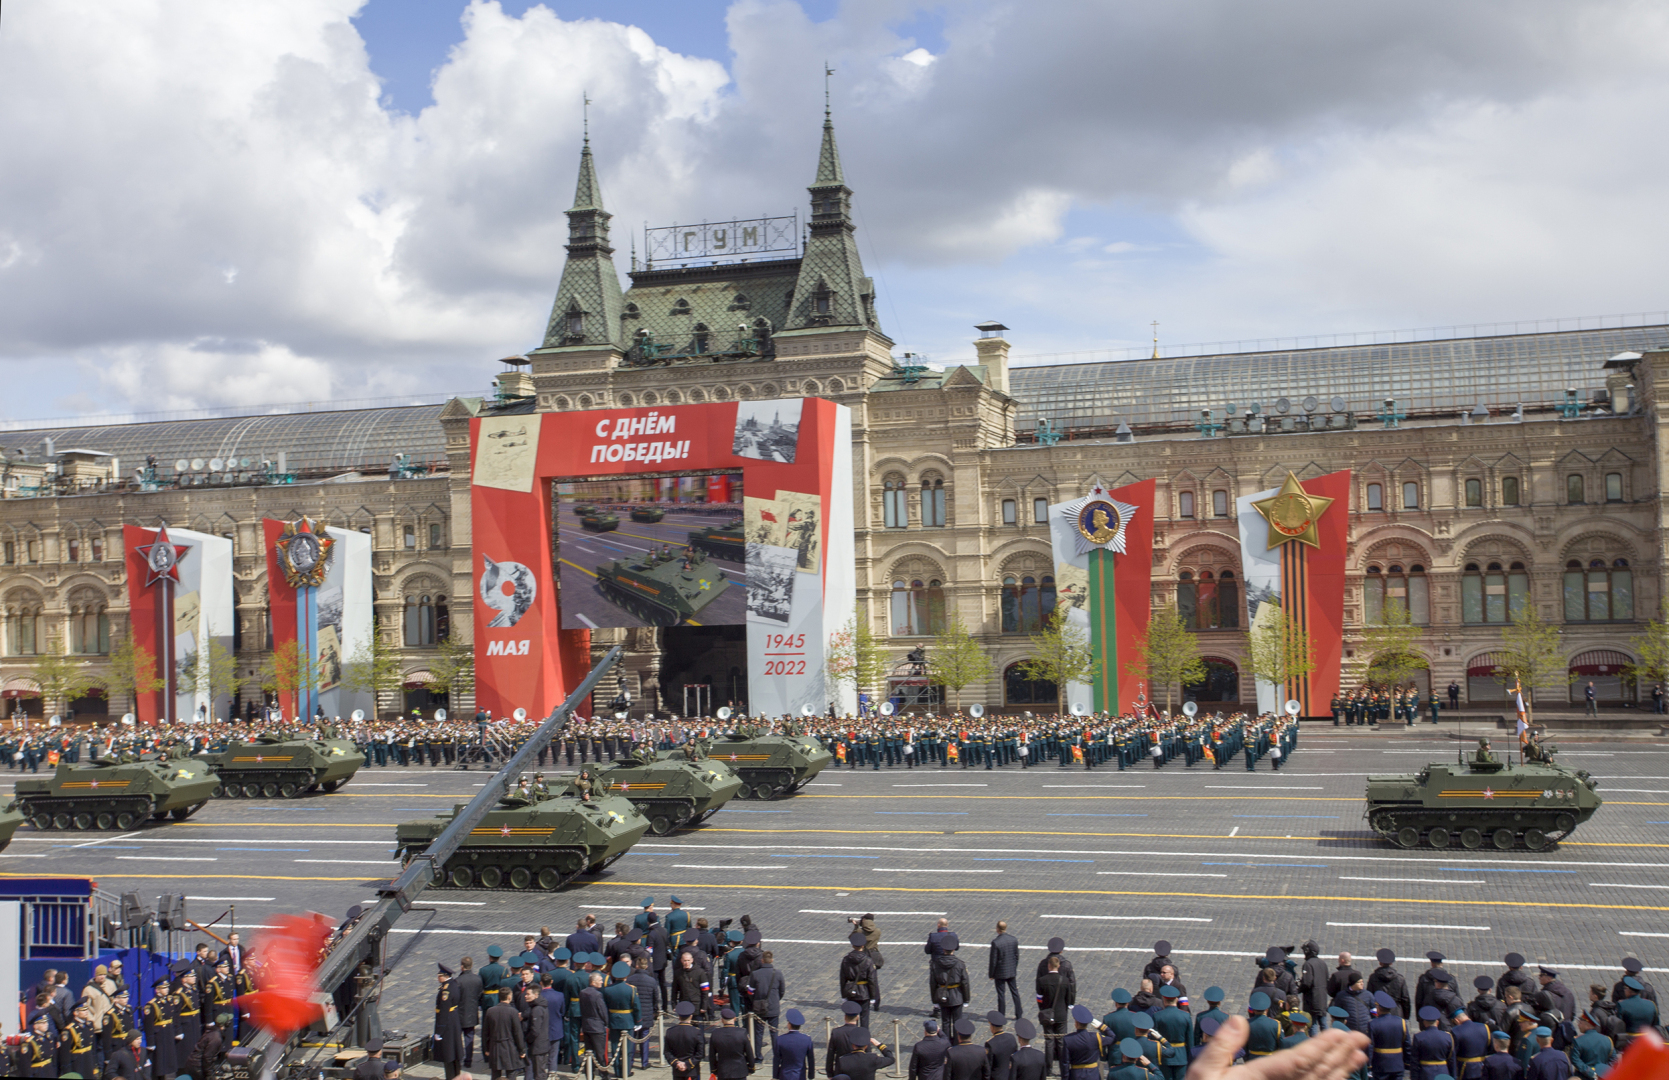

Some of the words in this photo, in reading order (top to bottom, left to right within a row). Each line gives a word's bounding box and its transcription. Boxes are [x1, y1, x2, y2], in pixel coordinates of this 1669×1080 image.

[684, 226, 757, 252] ГУМ
[595, 419, 610, 437] С
[611, 412, 676, 440] ДНЁМ
[590, 440, 691, 464] ПОБЕДЫ!
[480, 557, 537, 627] 9
[486, 639, 530, 656] МАЯ
[766, 633, 806, 649] 1945
[764, 660, 806, 676] 2022
